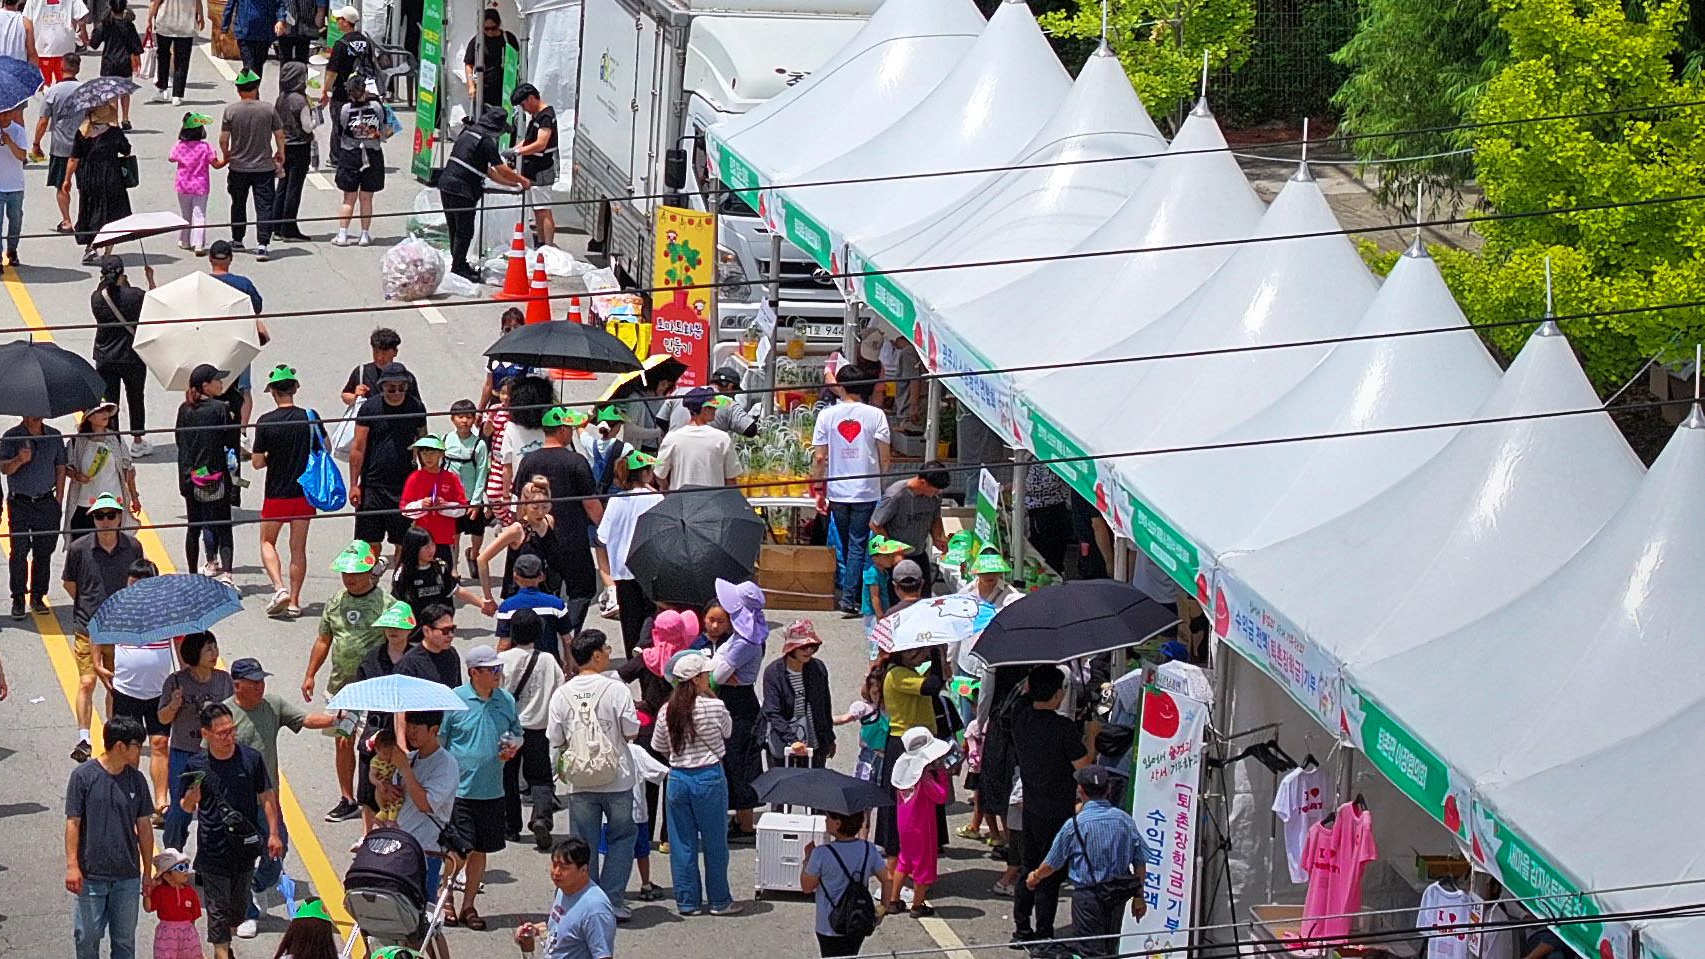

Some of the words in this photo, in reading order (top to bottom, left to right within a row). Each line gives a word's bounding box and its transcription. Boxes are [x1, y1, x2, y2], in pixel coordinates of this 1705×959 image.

[656, 317, 703, 340] 토마토화분
[663, 337, 692, 357] 만들기
[1235, 609, 1255, 643] 수익금
